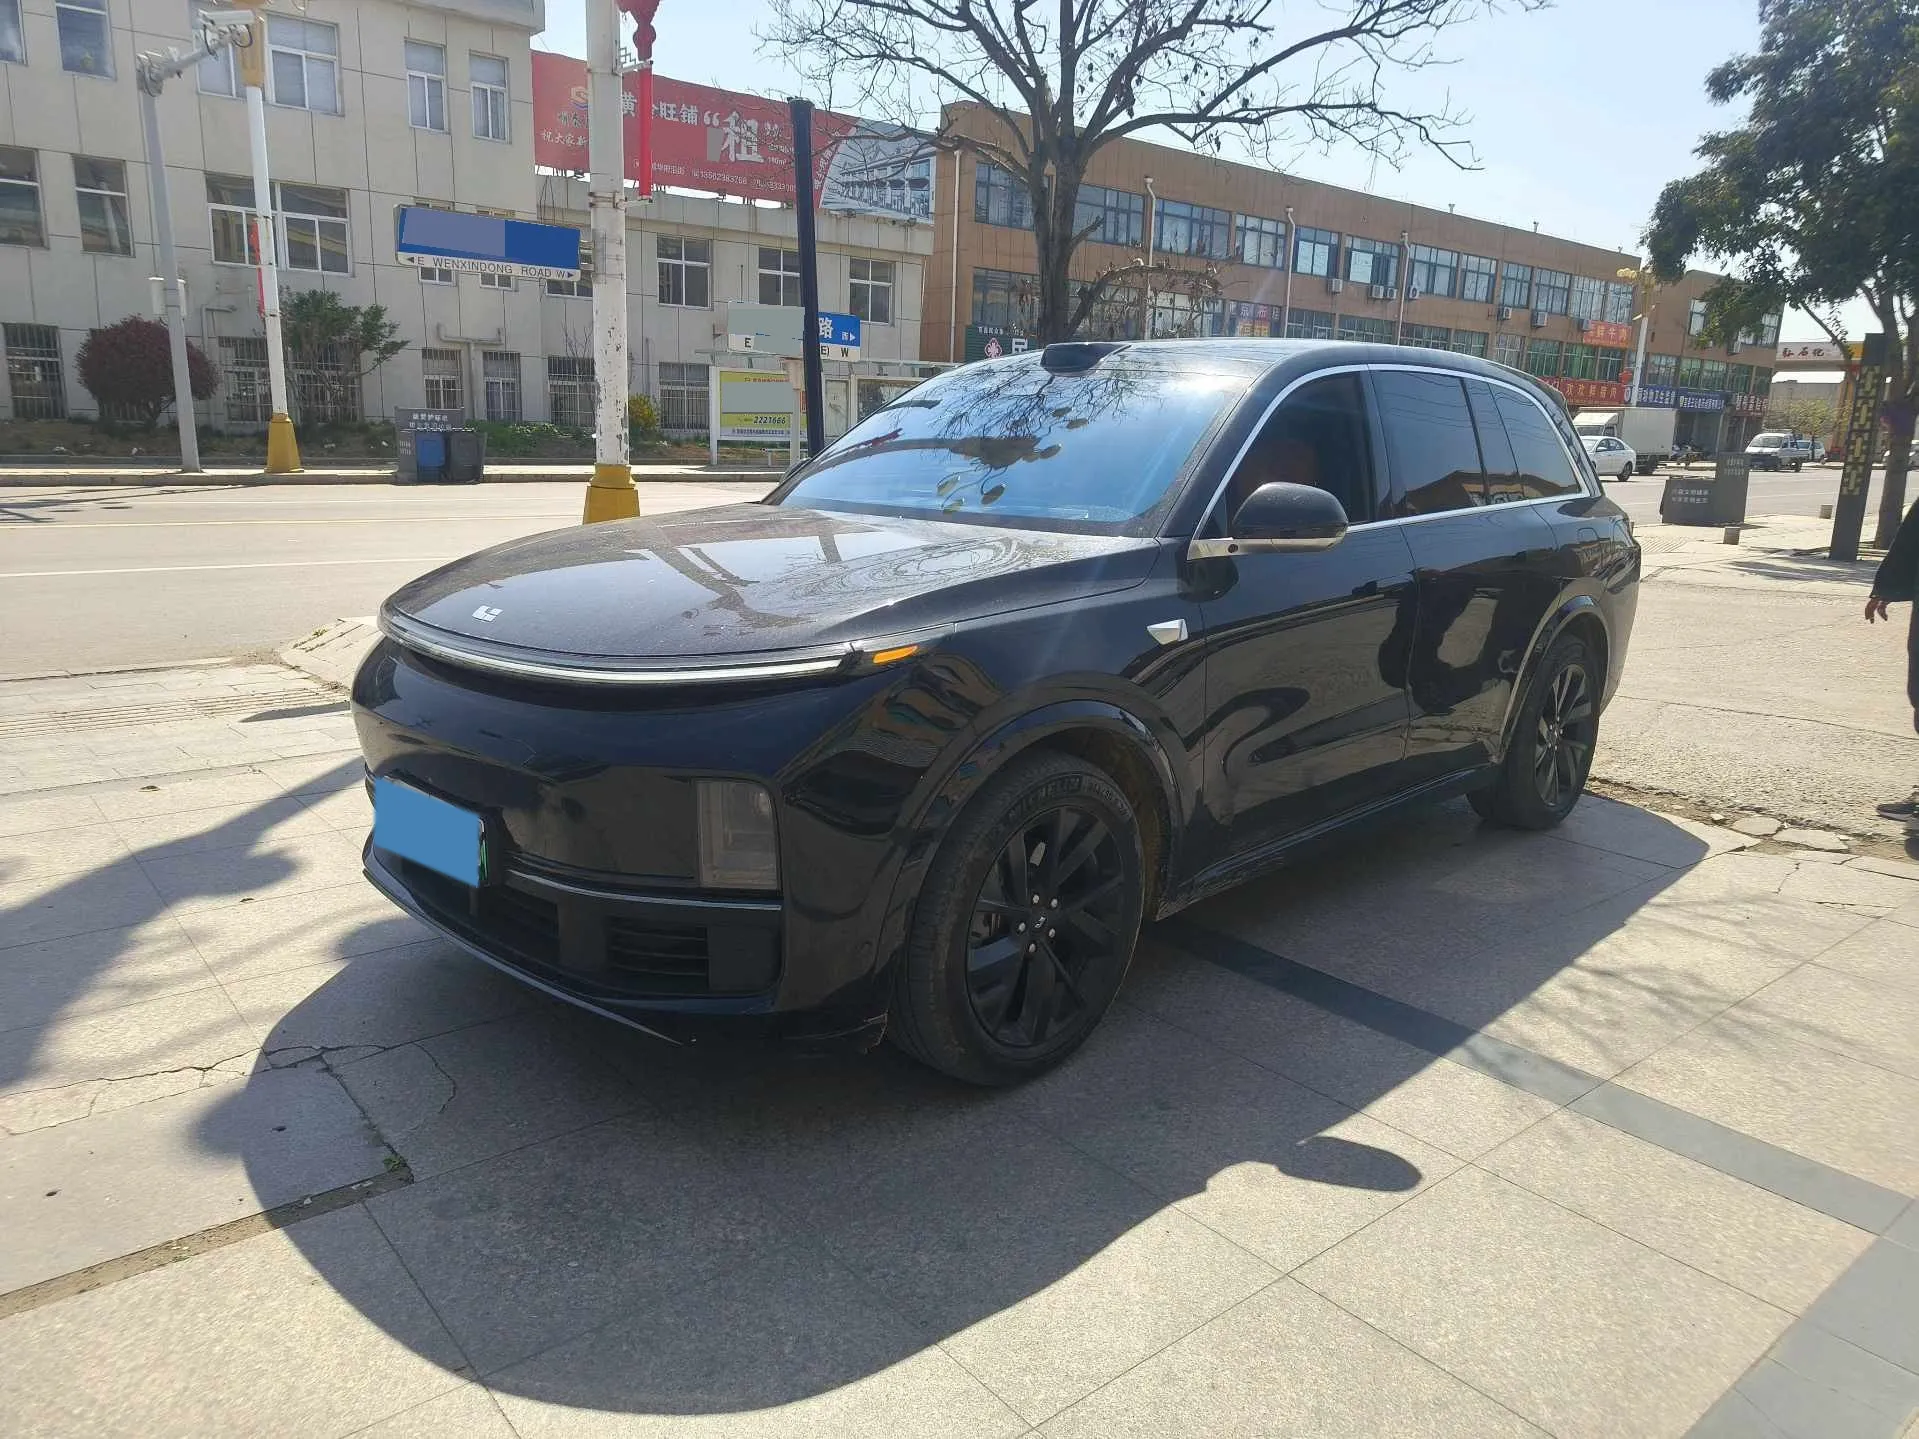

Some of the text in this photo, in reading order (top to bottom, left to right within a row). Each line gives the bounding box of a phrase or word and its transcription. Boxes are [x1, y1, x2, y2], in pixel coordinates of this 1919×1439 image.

[621, 91, 698, 126] 黄旺铺
[418, 256, 566, 279] E WENXINDONG ROAD W
[818, 317, 833, 339] 路
[744, 337, 752, 349] E
[841, 347, 849, 357] W
